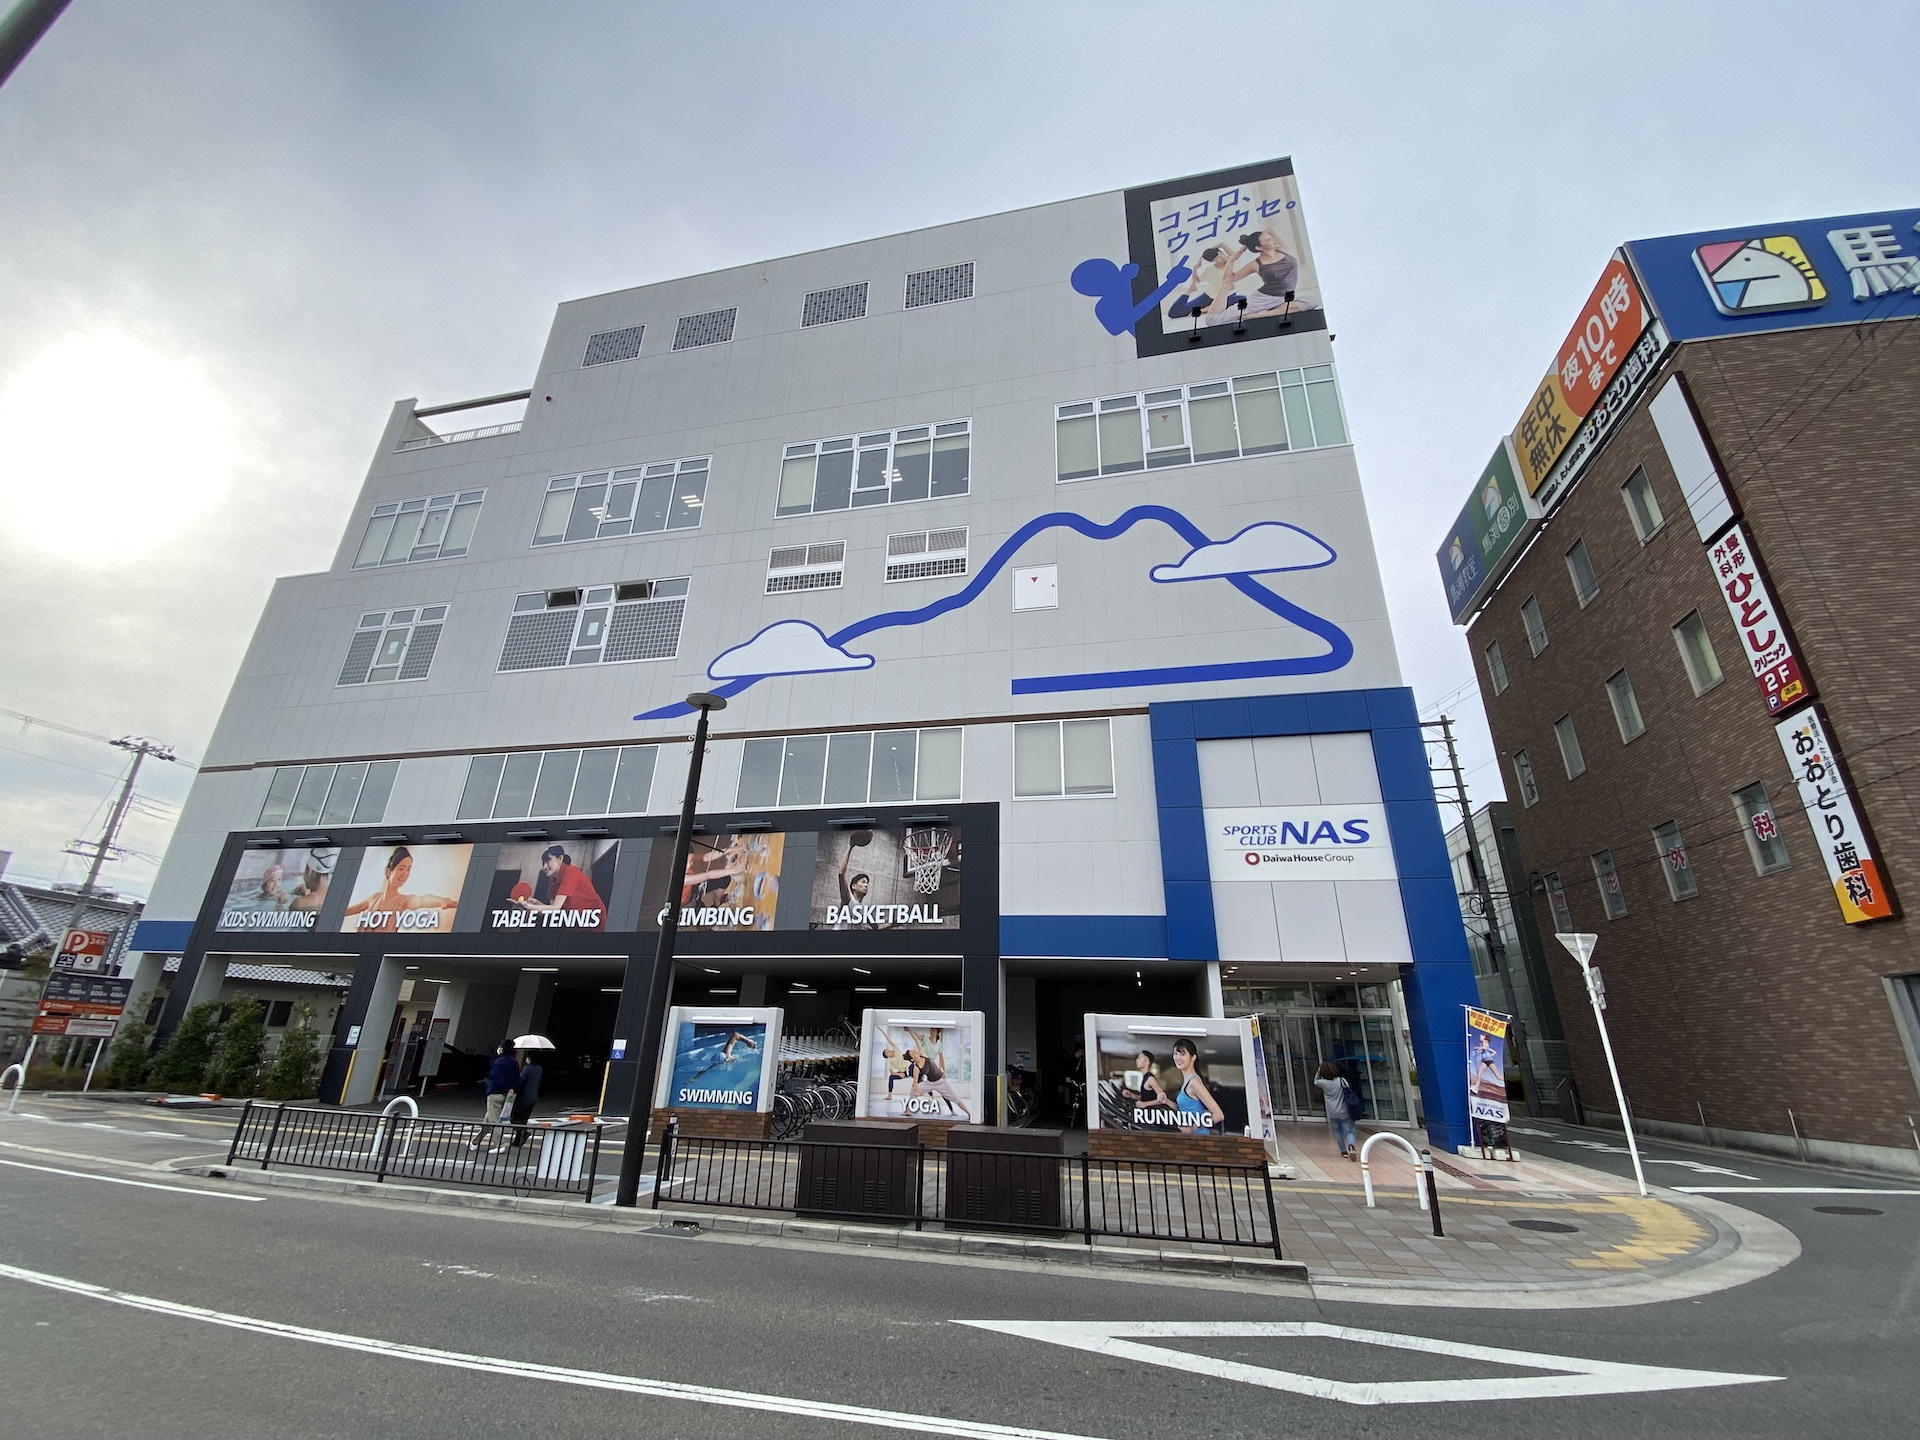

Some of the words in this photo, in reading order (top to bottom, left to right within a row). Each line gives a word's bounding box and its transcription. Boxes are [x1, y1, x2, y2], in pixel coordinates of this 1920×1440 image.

[1158, 188, 1251, 233] ココロ、
[1166, 199, 1296, 253] ウゴカセ。
[1826, 222, 1920, 300] 馬
[1561, 272, 1631, 391] 夜10時
[1588, 339, 1617, 391] まで
[1583, 330, 1660, 445] おおとり歯科
[1521, 384, 1556, 449] 年中
[1529, 412, 1567, 481] 無休
[1725, 572, 1776, 653] ひとし
[1754, 643, 1787, 673] クリニック
[1791, 727, 1875, 907] おおとり歯科
[1223, 825, 1277, 836] SPORTS
[1239, 836, 1276, 846] CLUB
[1280, 819, 1370, 845] NAS
[1263, 854, 1293, 863] Daiwa
[1293, 853, 1323, 862] House
[1324, 853, 1354, 863] Group
[220, 911, 249, 928] KIDS
[250, 910, 317, 928] SWIMMING
[356, 910, 392, 928] HOT
[394, 910, 439, 928] YOGA
[491, 910, 539, 928] TABLE
[541, 908, 602, 928] TENNIS
[657, 906, 755, 926] CIMBING
[826, 904, 944, 925] BASKETBALL
[89, 937, 106, 946] 24h
[678, 1088, 753, 1105] SWIMMING
[900, 1098, 940, 1114] YOGA
[1133, 1108, 1214, 1128] RUNNING
[1475, 1106, 1504, 1119] NAS
